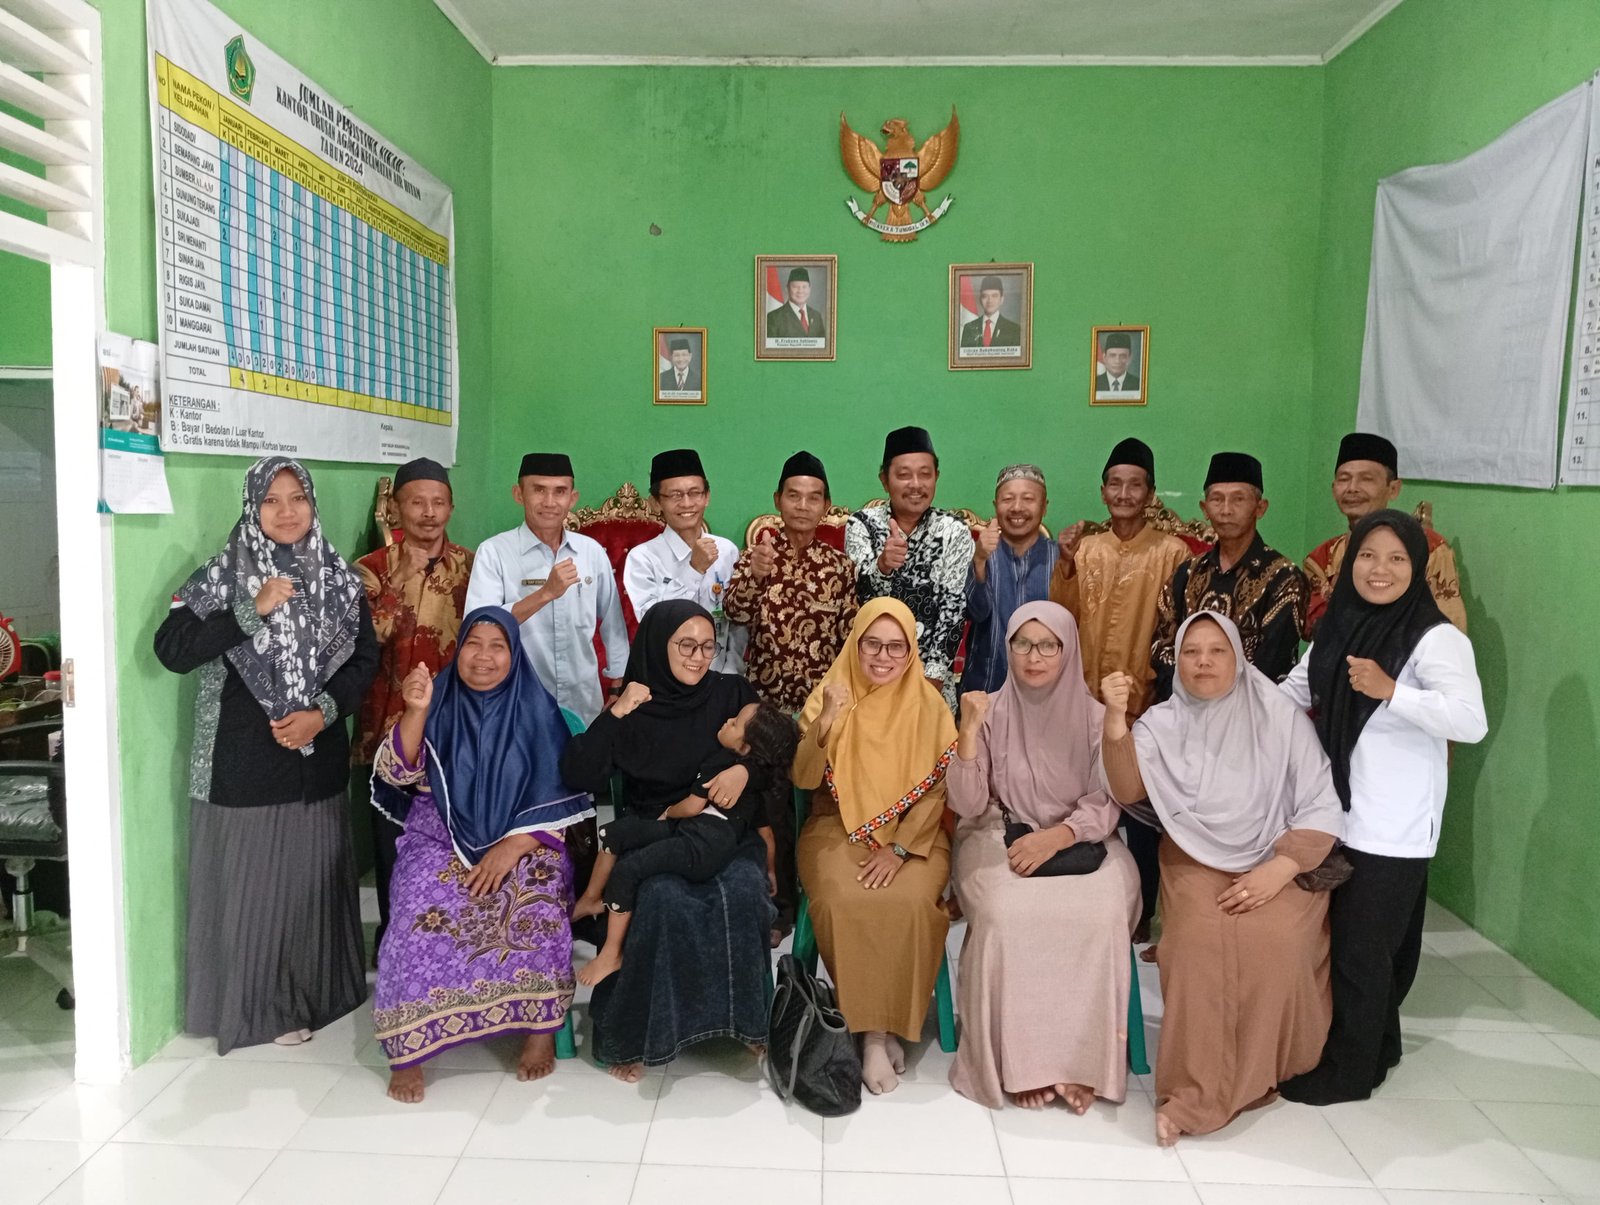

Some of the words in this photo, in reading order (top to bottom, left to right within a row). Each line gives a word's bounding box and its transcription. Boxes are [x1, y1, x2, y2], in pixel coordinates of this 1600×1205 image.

[172, 78, 191, 97] NAMA
[192, 90, 212, 109] PEKON
[299, 83, 334, 122] JUMLAH
[173, 91, 209, 119] KELURAHAN
[223, 115, 243, 133] JANUARI
[276, 85, 308, 123] KANTOR
[310, 109, 336, 141] URUSAN
[337, 130, 360, 159] AGAMA
[247, 129, 269, 148] FEBRUARI
[162, 137, 166, 148] 2
[174, 143, 201, 167] SEMARANG
[201, 159, 215, 174] JAYA
[274, 146, 289, 160] MARET
[320, 135, 344, 165] TAHUN
[344, 152, 364, 177] 2024
[162, 159, 167, 170] 3
[164, 181, 168, 192] 4
[175, 187, 197, 206] GUNUNG
[196, 197, 216, 215] TERANG
[164, 203, 168, 215] 5
[164, 226, 169, 237] 6
[177, 230, 186, 242] SRI
[185, 234, 207, 252] MENANTI
[222, 228, 227, 241] 2
[272, 230, 277, 241] 2
[165, 247, 170, 258] 7
[178, 252, 194, 267] SINAR
[194, 258, 206, 271] JAYA
[178, 274, 194, 288] RIGIS
[194, 278, 206, 292] JAYA
[166, 292, 171, 302] 9
[179, 295, 194, 309] SUKA
[195, 300, 212, 314] DAMAI
[166, 314, 173, 325] 10
[179, 316, 213, 334] MANGGARAI
[174, 340, 197, 352] JUMLAH
[197, 344, 220, 357] SATUAN
[262, 358, 267, 368] 2
[277, 362, 282, 372] 2
[284, 364, 289, 374] 2
[188, 365, 207, 377] TOTAL
[263, 379, 268, 390] 2
[1580, 386, 1590, 396] 10.
[168, 394, 217, 410] KETERANGAN
[169, 407, 175, 418] K
[180, 409, 202, 421] Kantor
[1577, 411, 1588, 420] 11.
[170, 420, 176, 431] B
[181, 421, 200, 435] Bayar
[205, 423, 231, 436] Bedolan
[171, 433, 178, 444] G
[183, 434, 202, 446] Gratis
[203, 436, 224, 448] karena
[224, 437, 241, 449] tidak
[241, 440, 260, 451] Mampu
[279, 442, 298, 453] bencana
[1575, 436, 1585, 445] 12.
